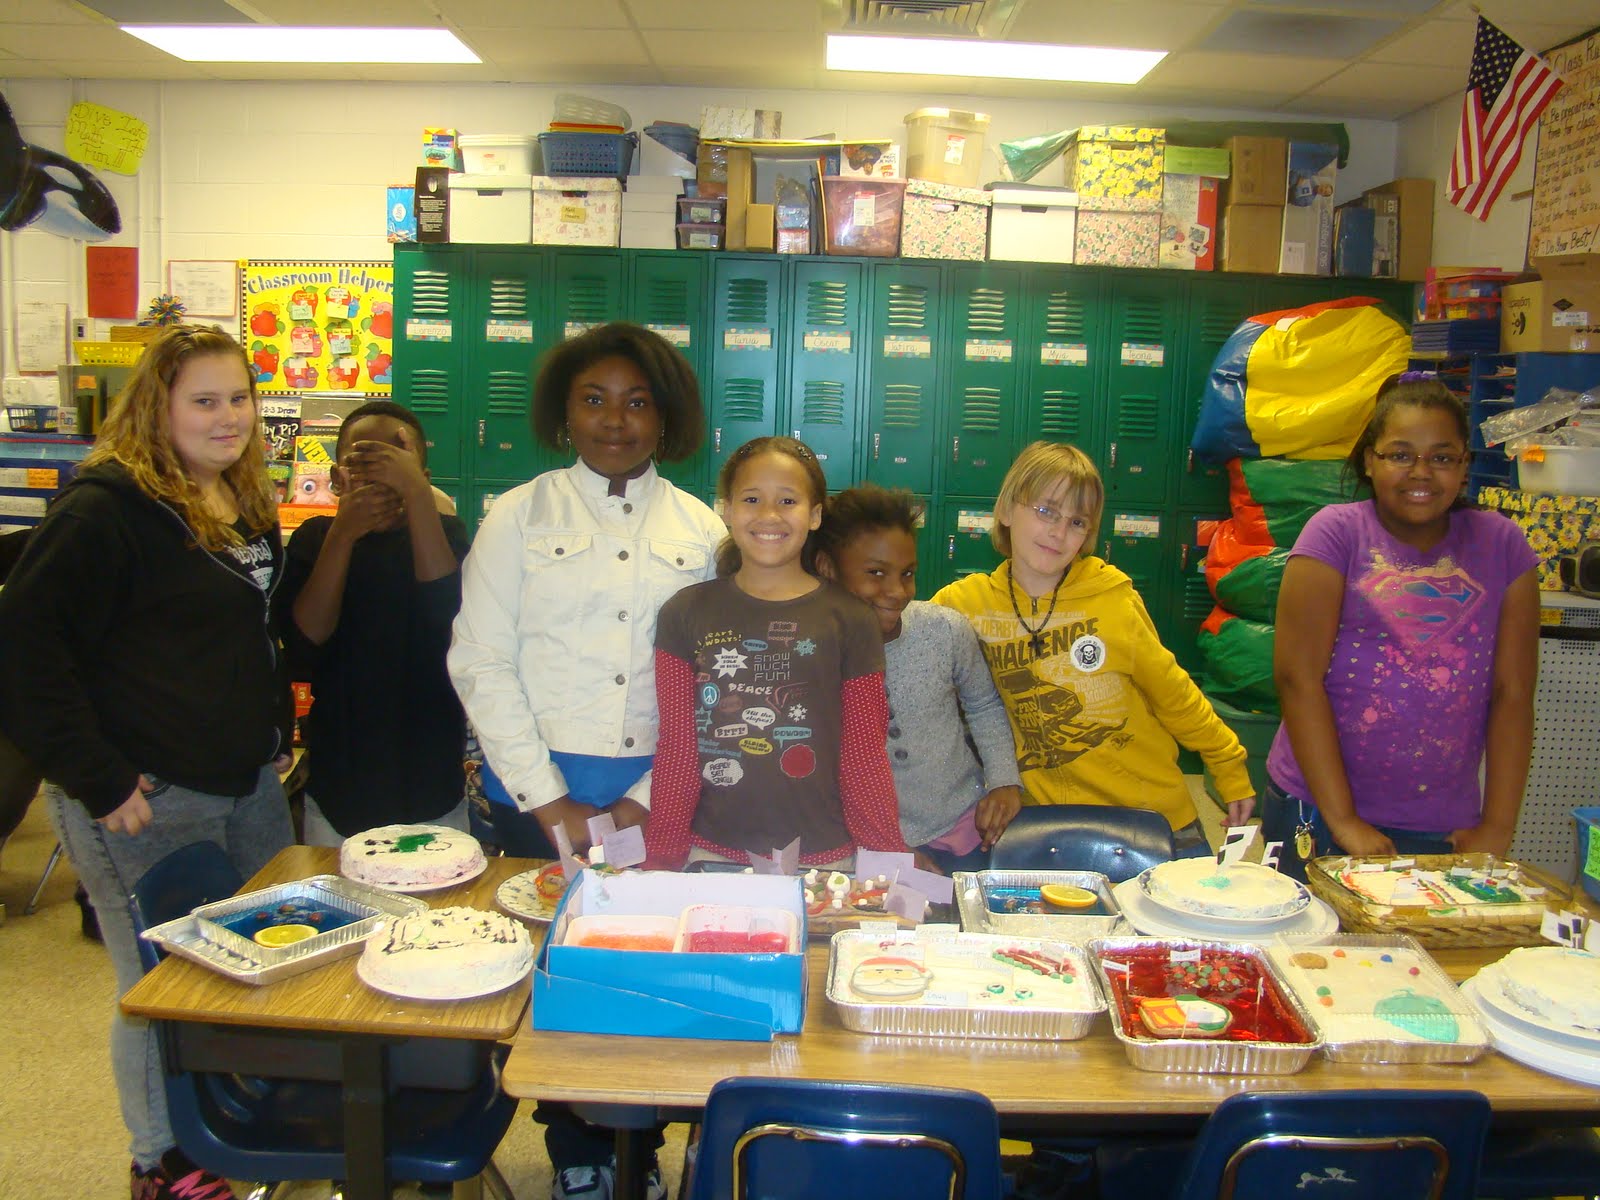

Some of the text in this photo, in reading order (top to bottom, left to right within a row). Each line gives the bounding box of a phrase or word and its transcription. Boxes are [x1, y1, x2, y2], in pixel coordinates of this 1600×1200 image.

[1553, 53, 1583, 75] Class
[74, 104, 112, 127] Dive
[247, 272, 332, 294] Classroom
[338, 269, 394, 293] Helper
[277, 406, 298, 414] Draw
[279, 423, 299, 436] Pi?
[980, 619, 1020, 639] DERBY
[728, 683, 773, 696] PEACE
[709, 762, 731, 771] READY
[711, 769, 724, 778] SET
